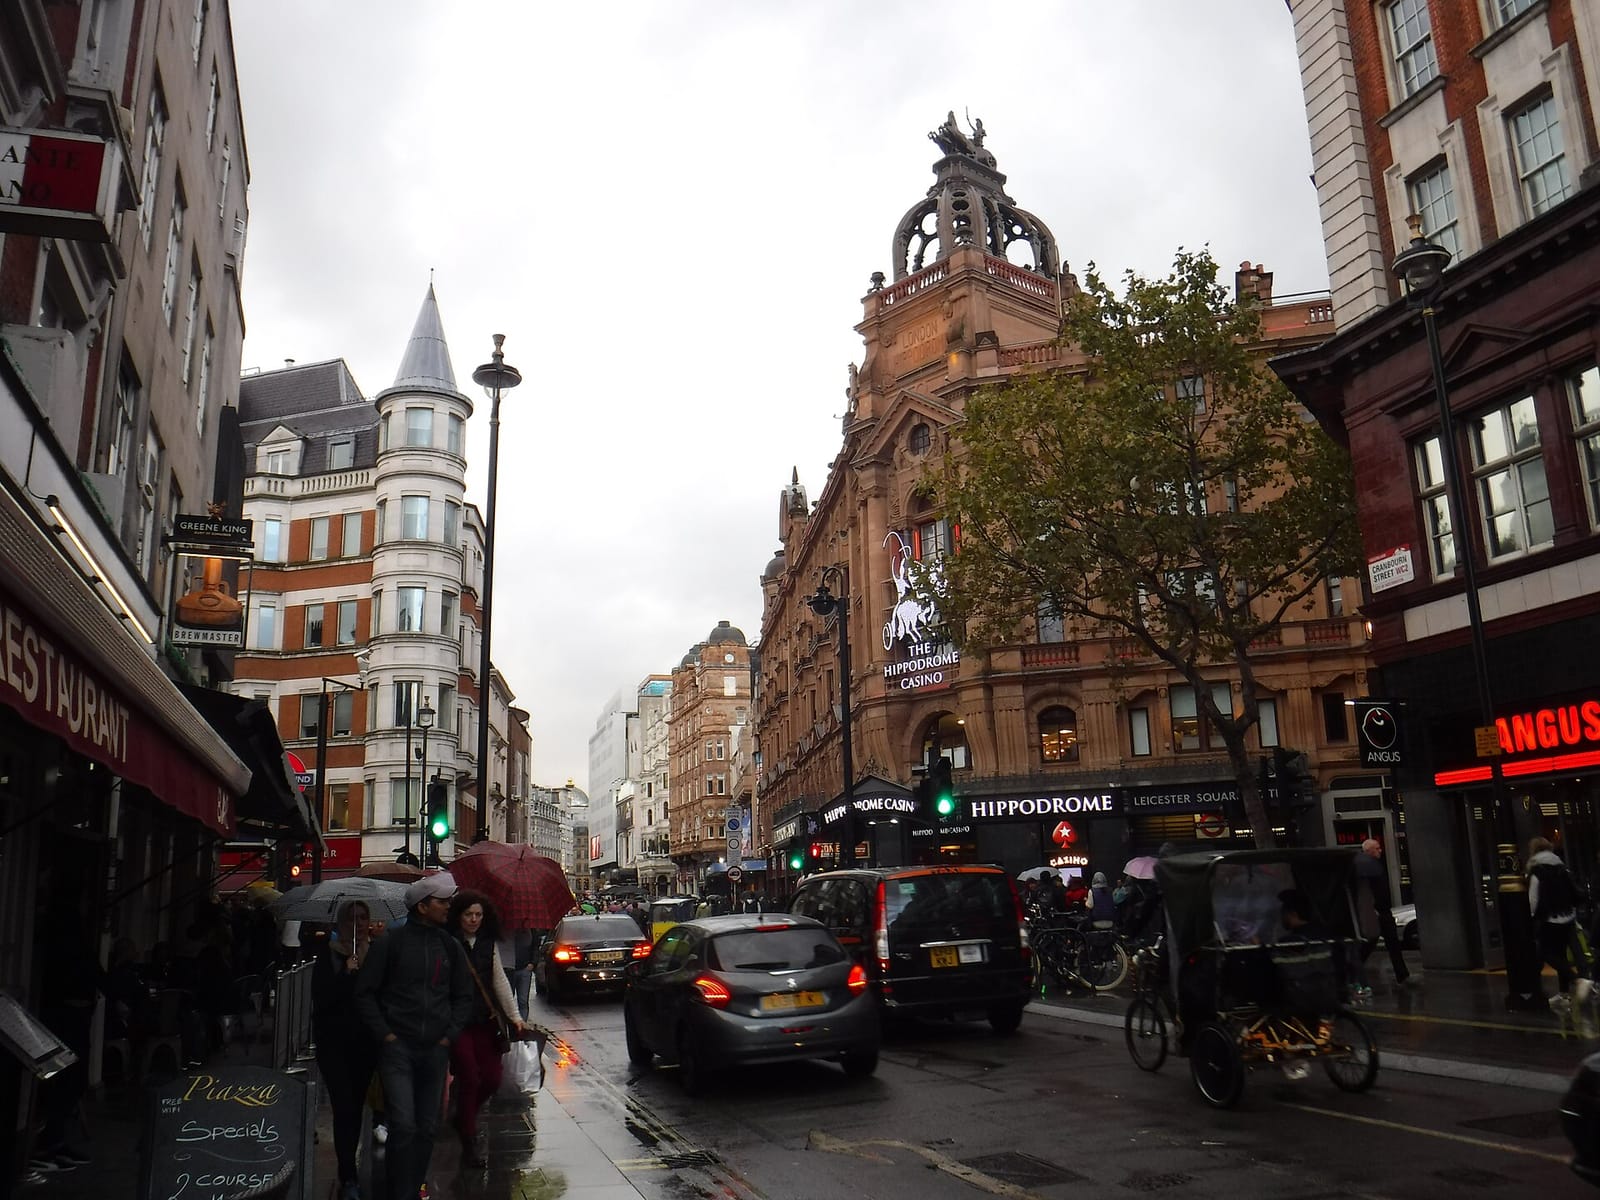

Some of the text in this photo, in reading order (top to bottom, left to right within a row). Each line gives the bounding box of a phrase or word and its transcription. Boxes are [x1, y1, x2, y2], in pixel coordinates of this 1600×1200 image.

[179, 521, 219, 533] GREENE
[221, 524, 247, 535] KING
[1373, 569, 1395, 583] STREET
[175, 631, 240, 642] BREWMASTER
[908, 642, 931, 657] THE
[884, 651, 959, 678] HIPPODROME
[0, 606, 129, 764] ESTAURANT
[901, 671, 943, 689] CASINO
[1495, 700, 1600, 754] ANGUS
[1367, 751, 1401, 763] ANGUS
[885, 798, 916, 812] CASIN
[971, 795, 1113, 817] HIPPODROME
[1134, 791, 1240, 806] LEICESTER SQUAR
[183, 1074, 282, 1108] Piazza
[161, 1098, 182, 1106] FREE
[175, 1118, 280, 1142] Specials
